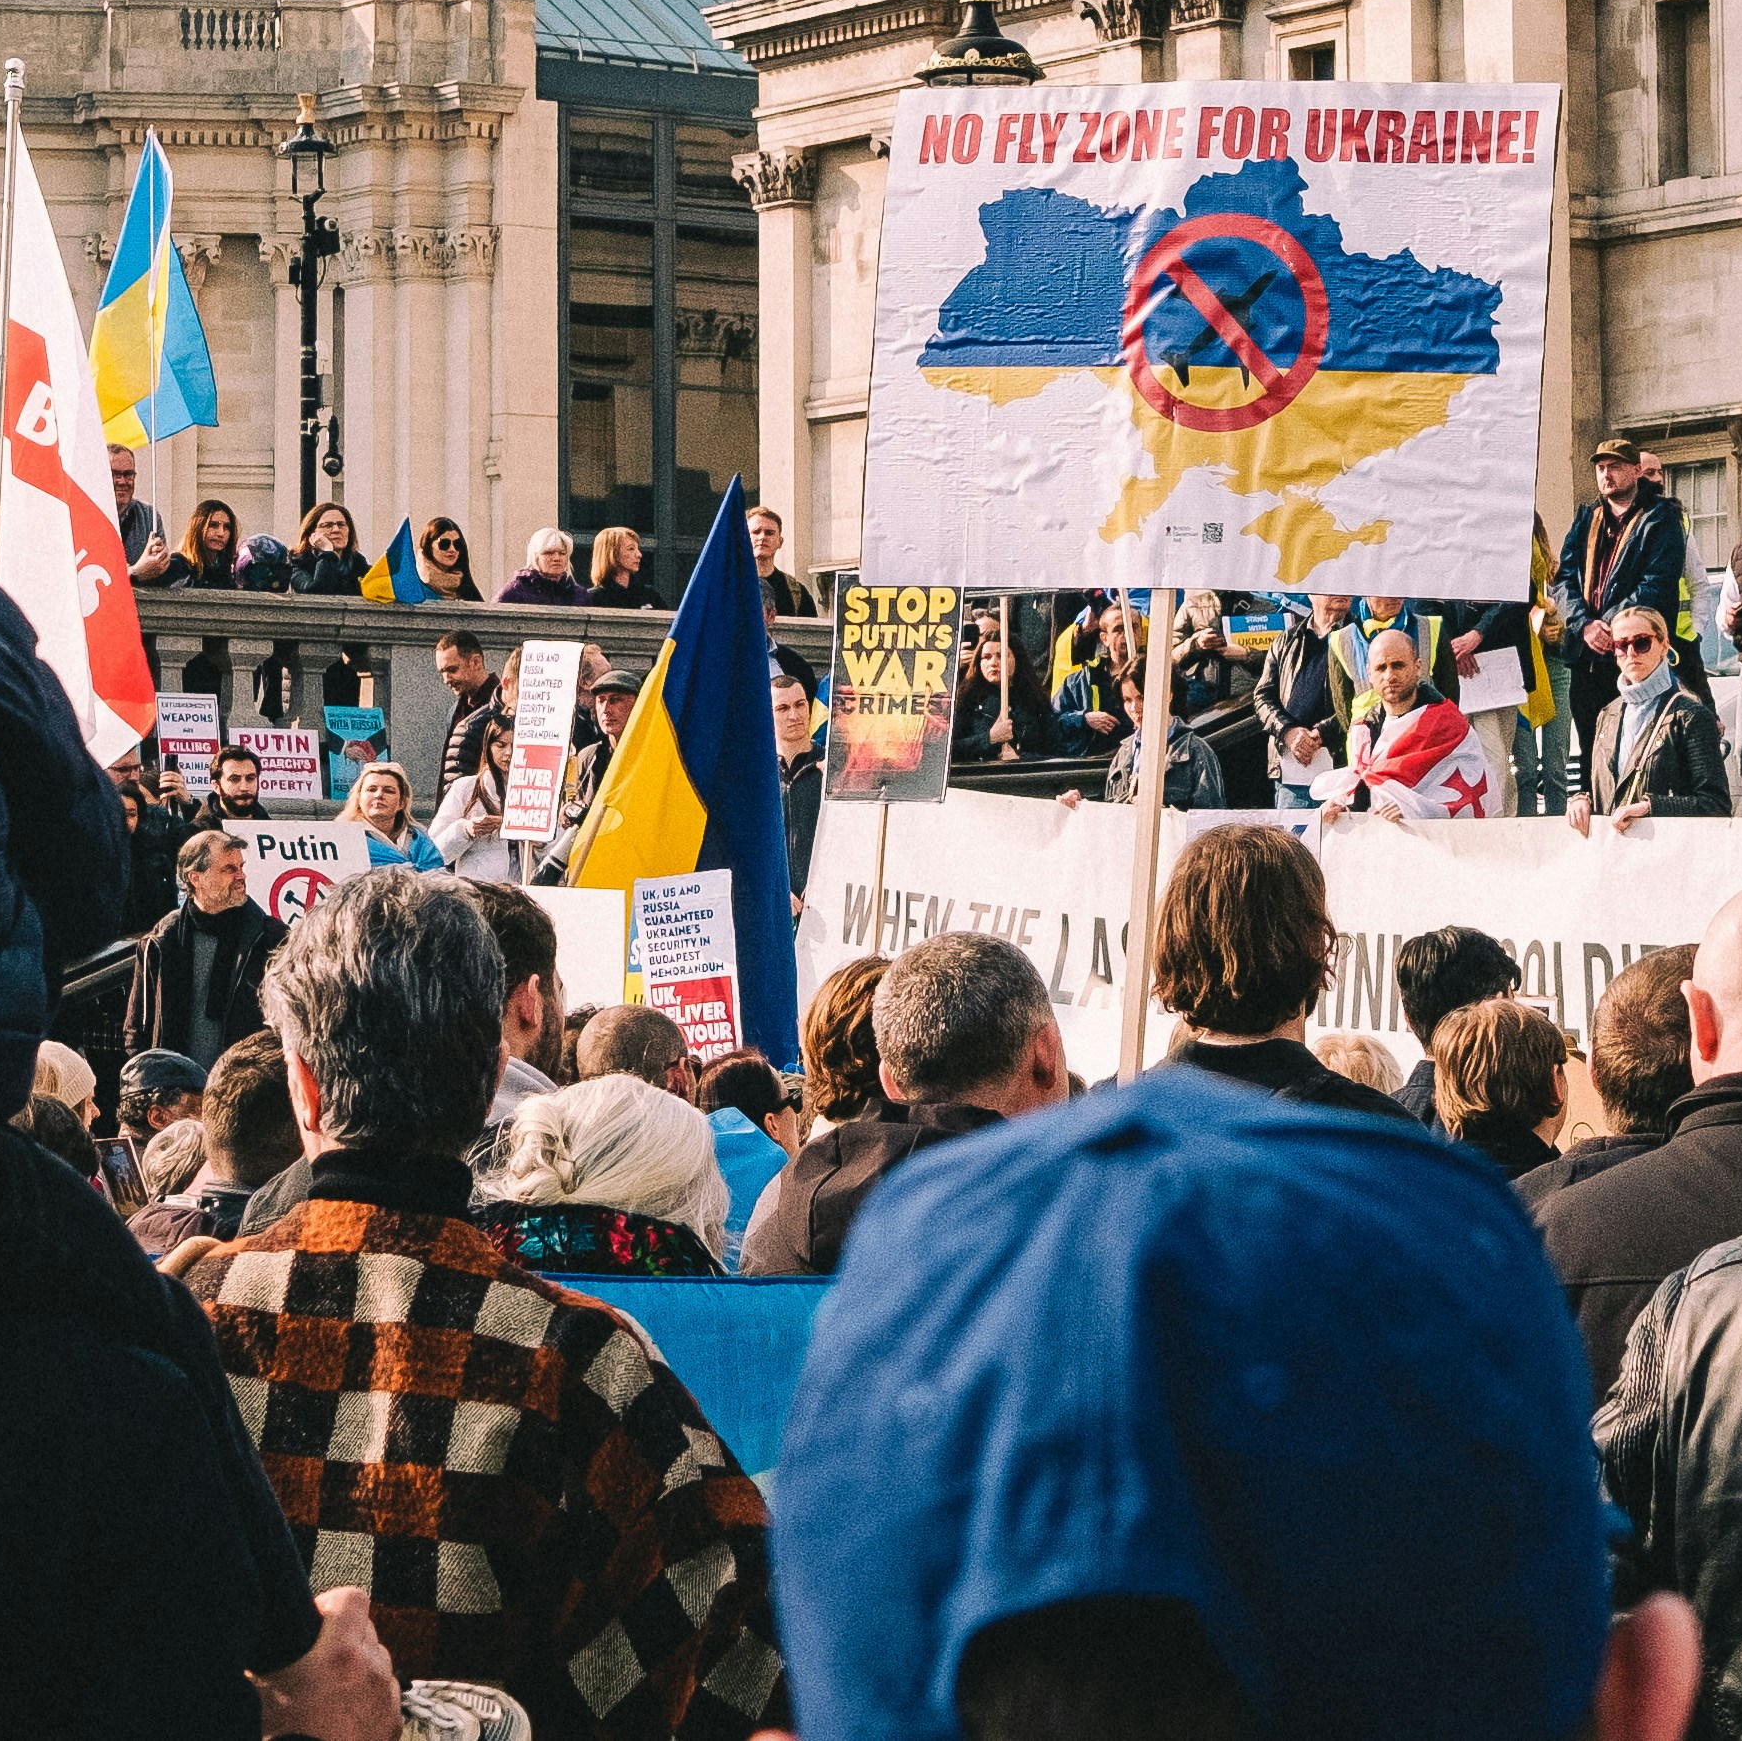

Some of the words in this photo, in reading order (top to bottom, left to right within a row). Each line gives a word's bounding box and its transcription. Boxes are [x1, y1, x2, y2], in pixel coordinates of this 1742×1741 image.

[919, 113, 984, 164] NO
[993, 112, 1069, 164] FLY
[1073, 107, 1187, 164] ZONE
[1197, 105, 1291, 161] FOR
[1304, 108, 1540, 164] UKRAINE!
[844, 586, 957, 624] STOP
[843, 624, 953, 650] PUTIN'S
[1238, 637, 1275, 647] UKRAIN
[841, 650, 949, 693] WAR
[161, 712, 214, 723] WEAPONS
[168, 741, 212, 753] KILLING
[239, 733, 309, 754] PUTIN
[179, 761, 211, 771] RAINIA
[260, 757, 312, 771] GARCH'S
[260, 778, 313, 791] OPERTY
[256, 833, 339, 861] Putin
[642, 889, 660, 901] UK,
[663, 887, 676, 898] US
[679, 884, 701, 896] AND
[643, 900, 681, 914] RUSSIA
[644, 909, 714, 927] GUARANTEED
[842, 882, 956, 952] WHEN
[646, 924, 701, 940] UKRAINE'S
[647, 937, 697, 953] SECURITY
[699, 935, 711, 947] IN
[649, 950, 701, 966] BUDAPEST
[650, 961, 725, 979] MEMORANDUM
[651, 985, 682, 1007] UK,
[661, 1000, 728, 1025] ELIVER
[683, 1021, 734, 1044] YOUR
